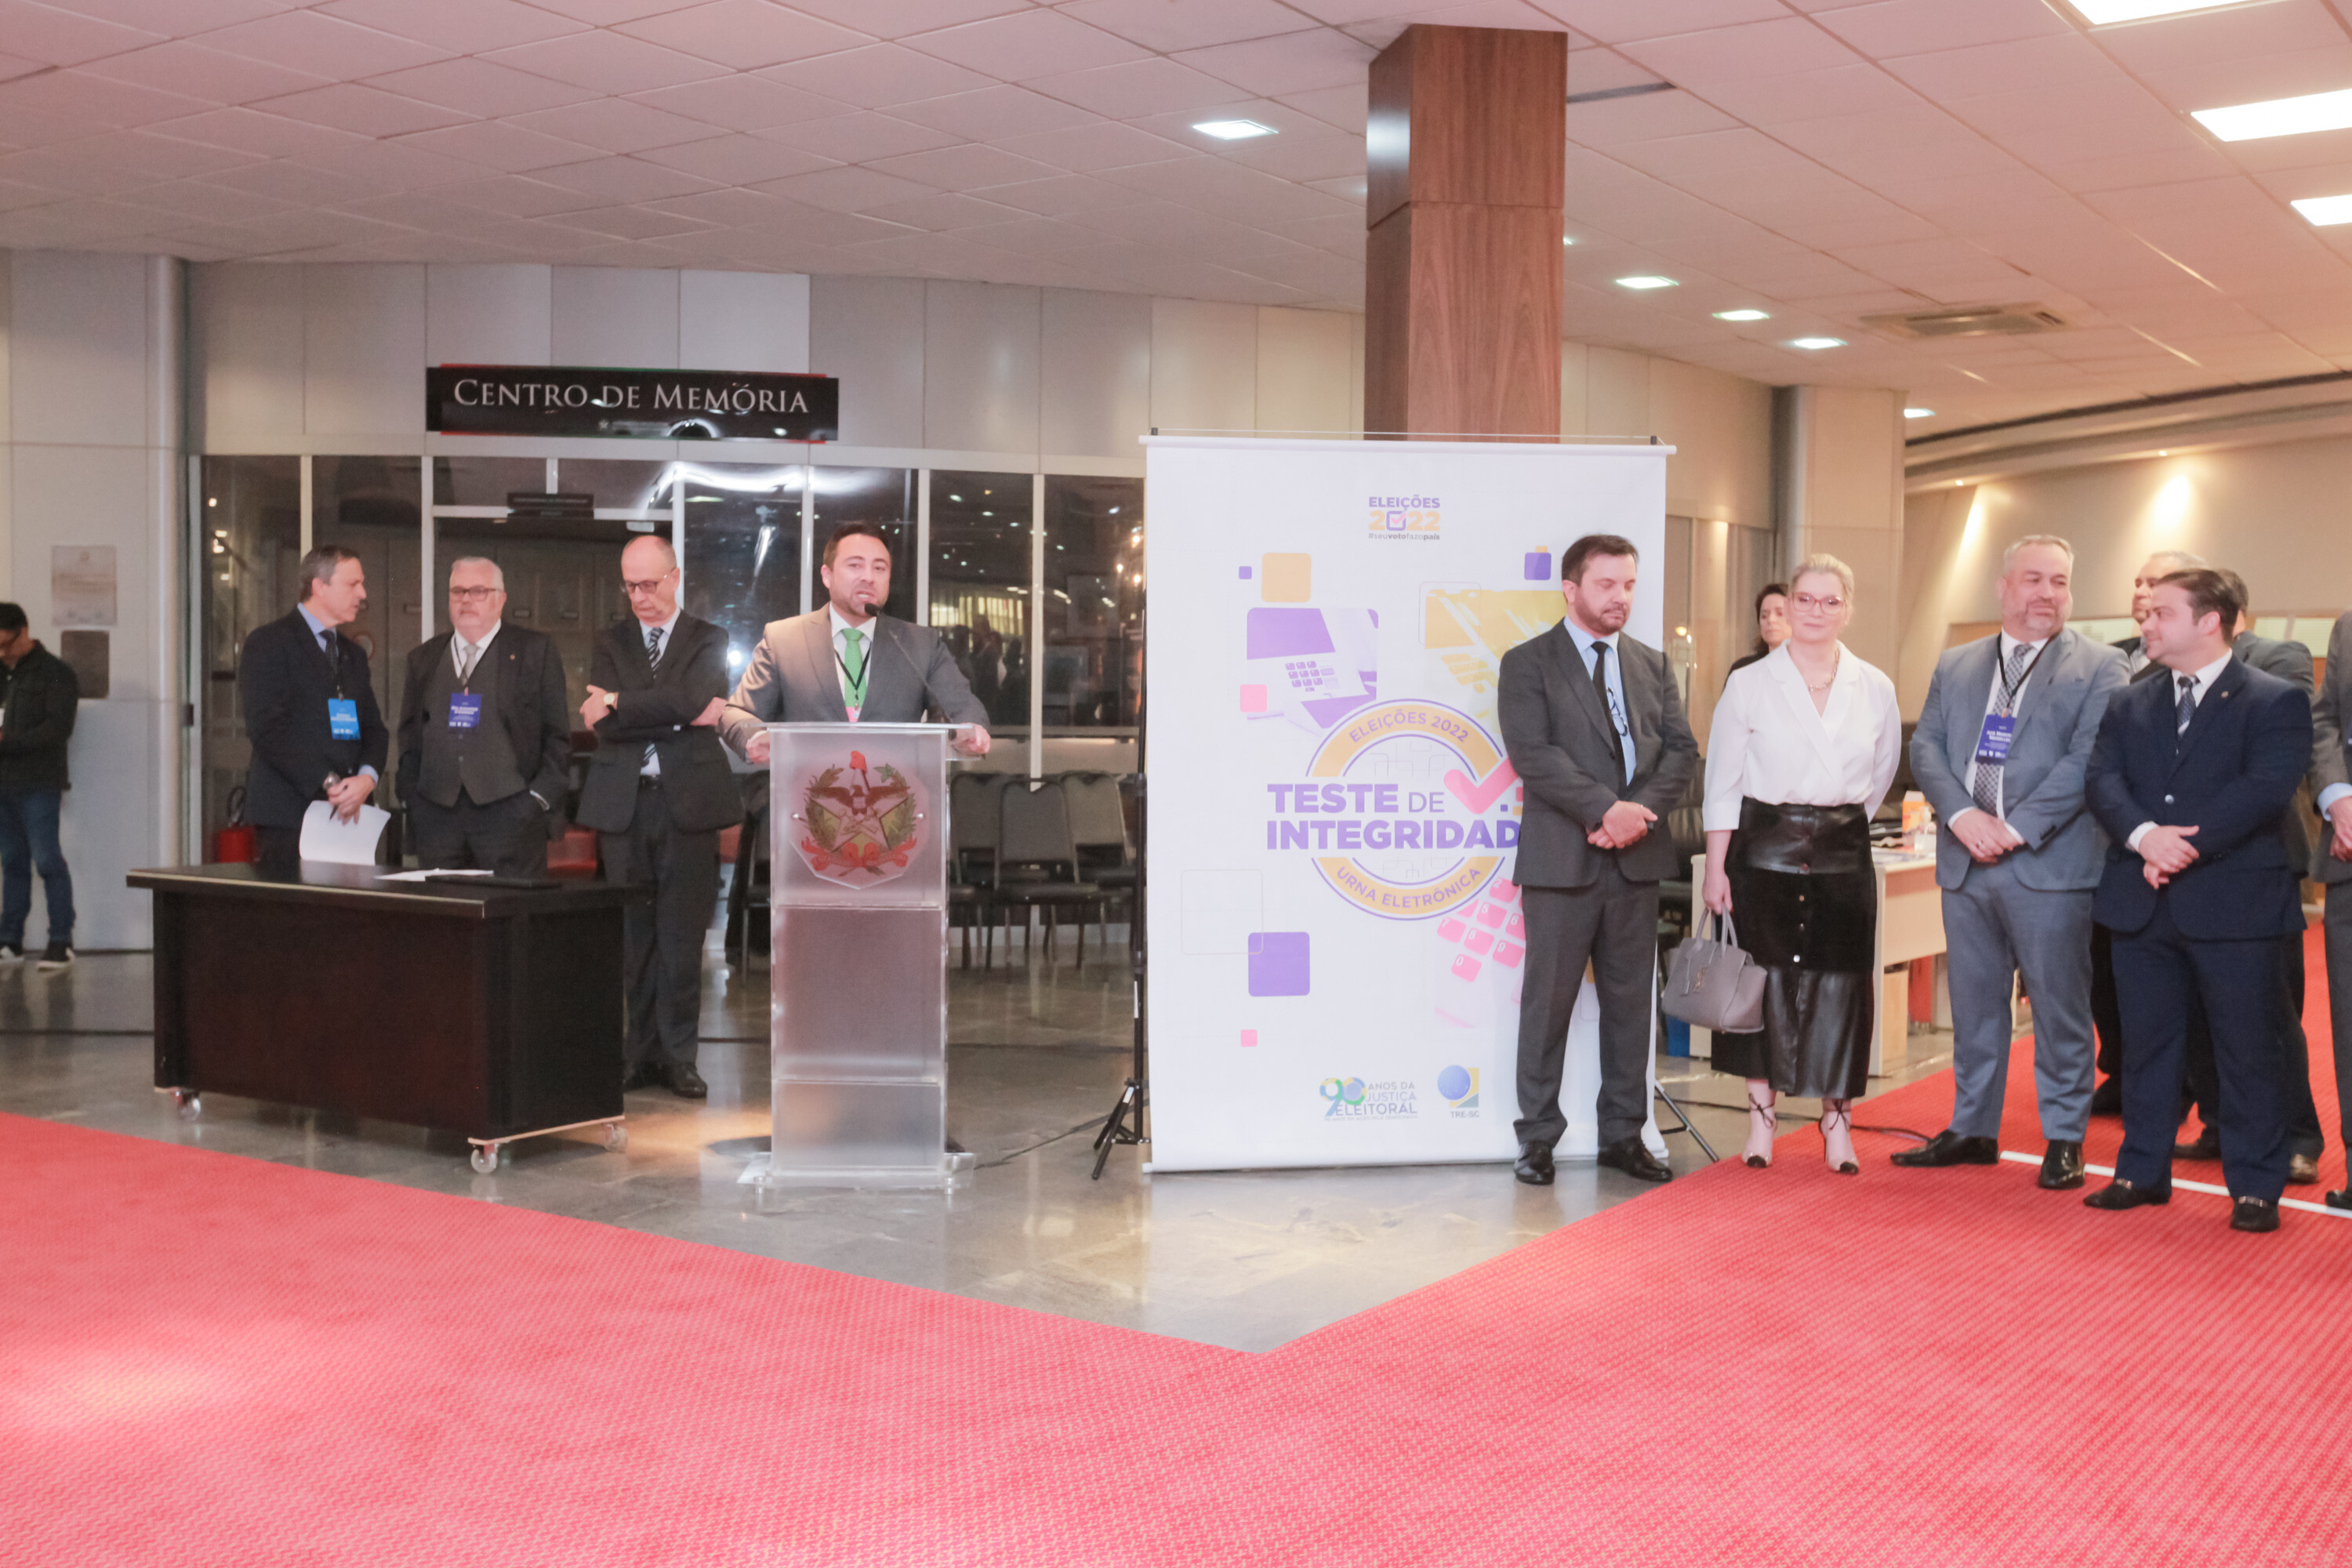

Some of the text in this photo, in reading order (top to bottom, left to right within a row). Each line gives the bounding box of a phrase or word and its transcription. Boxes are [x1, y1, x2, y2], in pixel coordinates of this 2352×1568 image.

[454, 379, 810, 414] CENTRO DE MEMÓRIA
[1369, 494, 1440, 510] ELEIÇÕES
[1348, 709, 1468, 742] ELEIÇÕES 2022
[1267, 783, 1445, 814] TESTE DE
[1337, 866, 1481, 908] URNA ELETRÔNICA
[1319, 1076, 1367, 1116] 90
[1366, 1091, 1417, 1102] JUSTIÇA
[1368, 1081, 1415, 1091] ANOS DA
[1335, 1102, 1417, 1116] ELEITORAL
